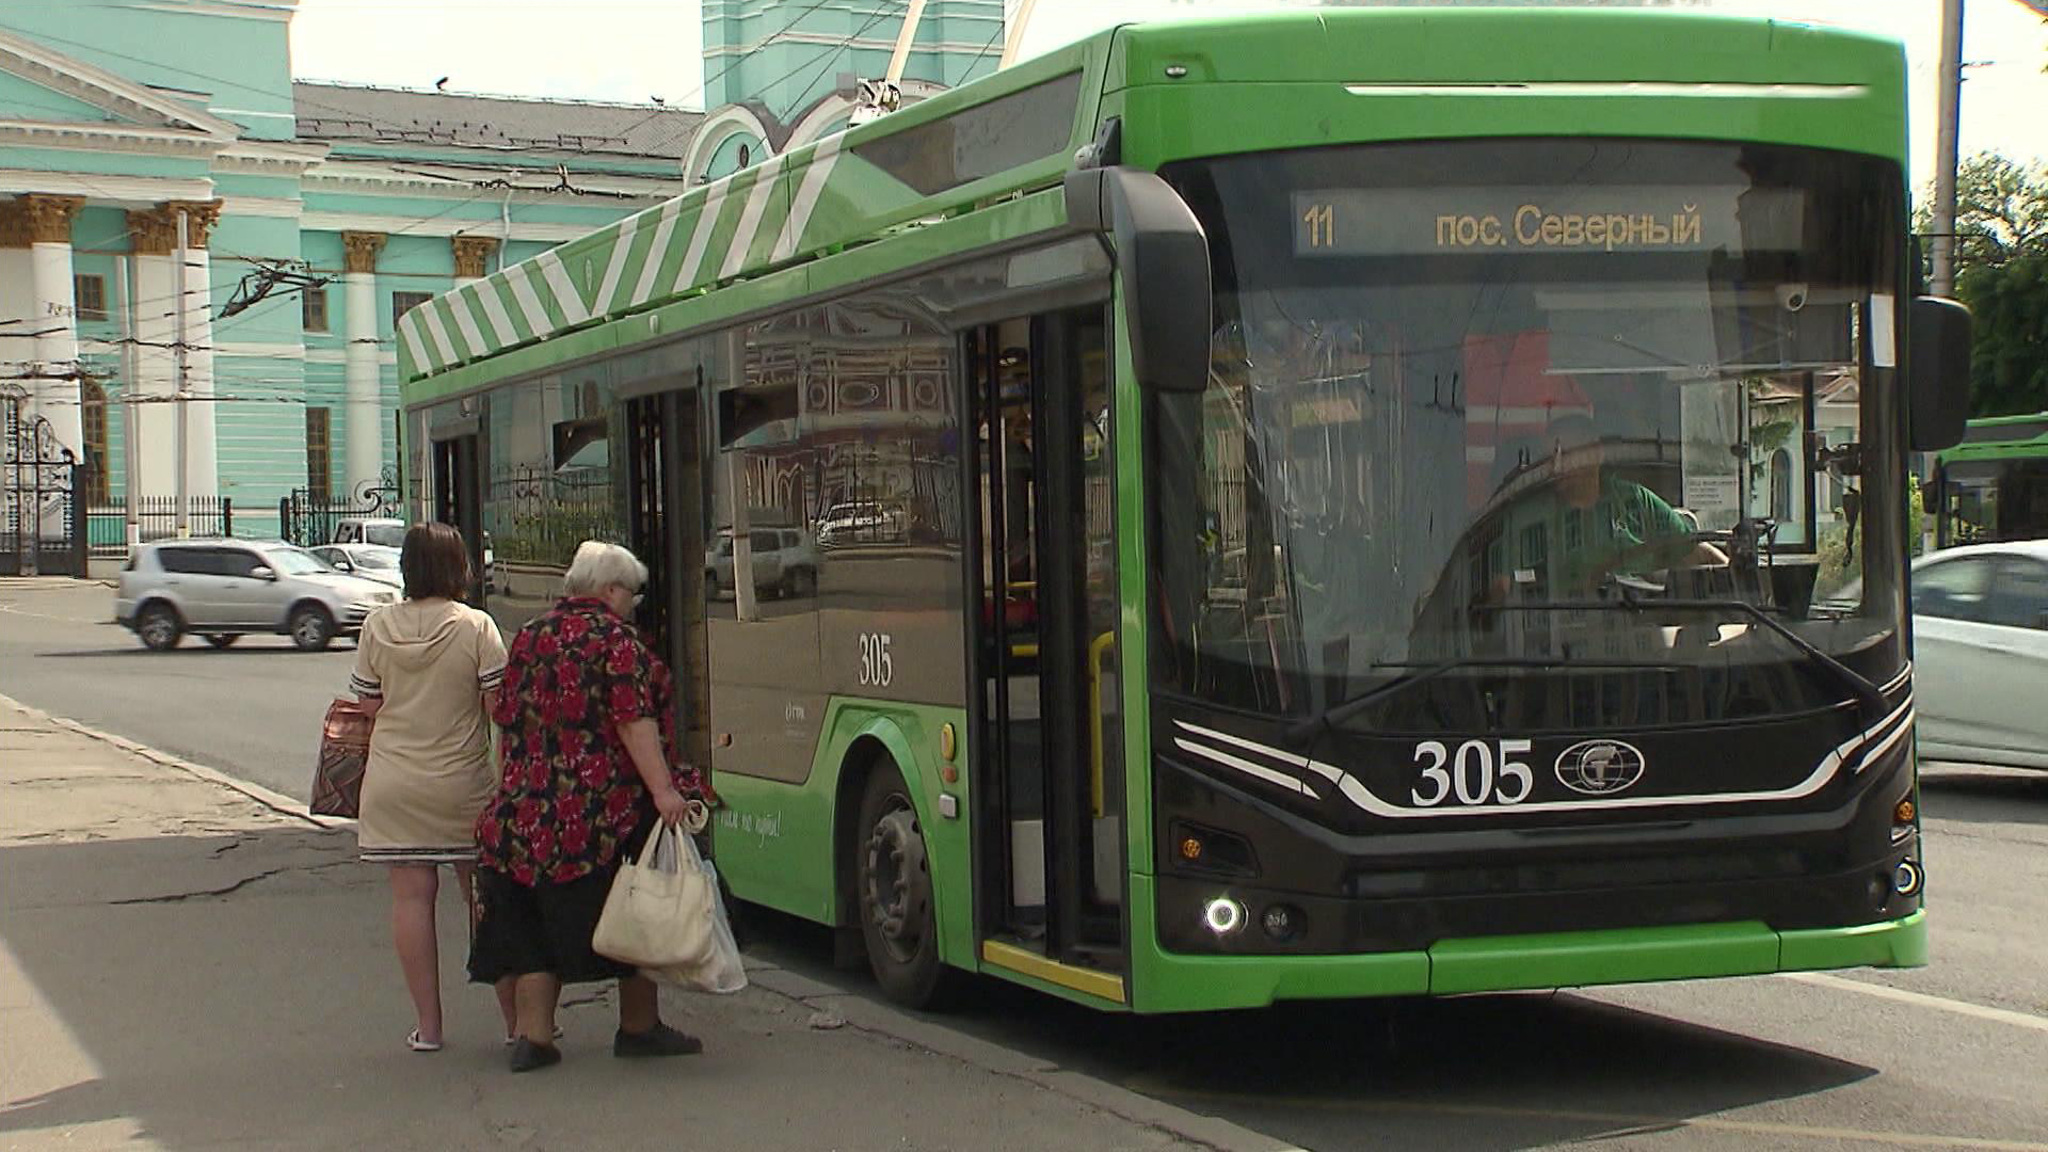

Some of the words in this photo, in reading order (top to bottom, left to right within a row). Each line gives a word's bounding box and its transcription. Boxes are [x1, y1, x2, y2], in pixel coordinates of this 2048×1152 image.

[1303, 204, 1334, 247] 11
[1436, 214, 1507, 246] пос.
[1514, 203, 1701, 251] Северный
[858, 632, 892, 686] 305
[1411, 739, 1533, 806] 305
